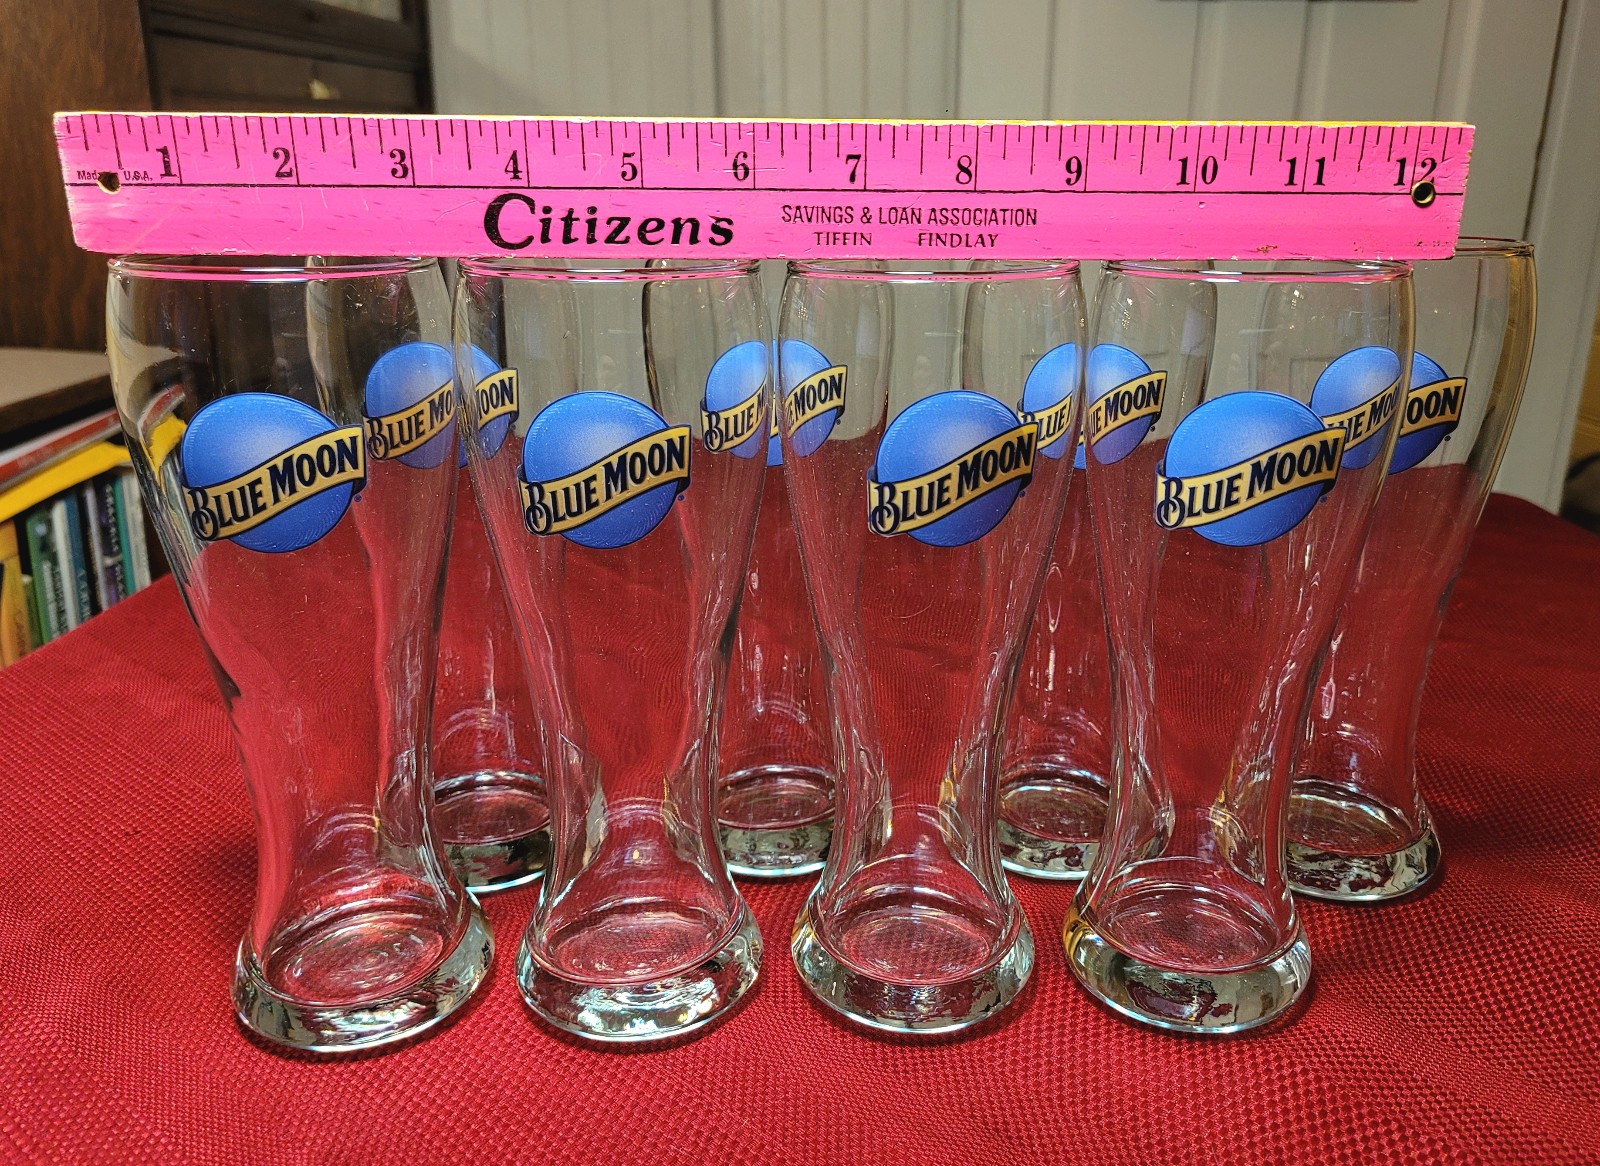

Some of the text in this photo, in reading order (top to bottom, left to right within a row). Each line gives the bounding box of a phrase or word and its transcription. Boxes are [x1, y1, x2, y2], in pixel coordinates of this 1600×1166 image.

[77, 170, 99, 180] Mad
[156, 146, 1437, 186] 1 2 3 4 5 6 7 8 9 10 11 12
[484, 193, 734, 251] Citizens
[782, 205, 1038, 227] SAVINGS & LOAN ASSOCIATION
[816, 232, 999, 248] TIFFIN FINDLAY
[794, 373, 843, 421] MOON
[1104, 379, 1164, 428] MOON
[1402, 386, 1463, 430] OON
[367, 410, 425, 459] BLUE
[704, 403, 755, 451] BLUE
[187, 477, 267, 541] BLUE
[267, 435, 358, 505] MOON
[525, 435, 687, 534] BLUE MOON
[871, 433, 1034, 534] BLUE MOON
[1156, 438, 1340, 528] BLUE MOON
